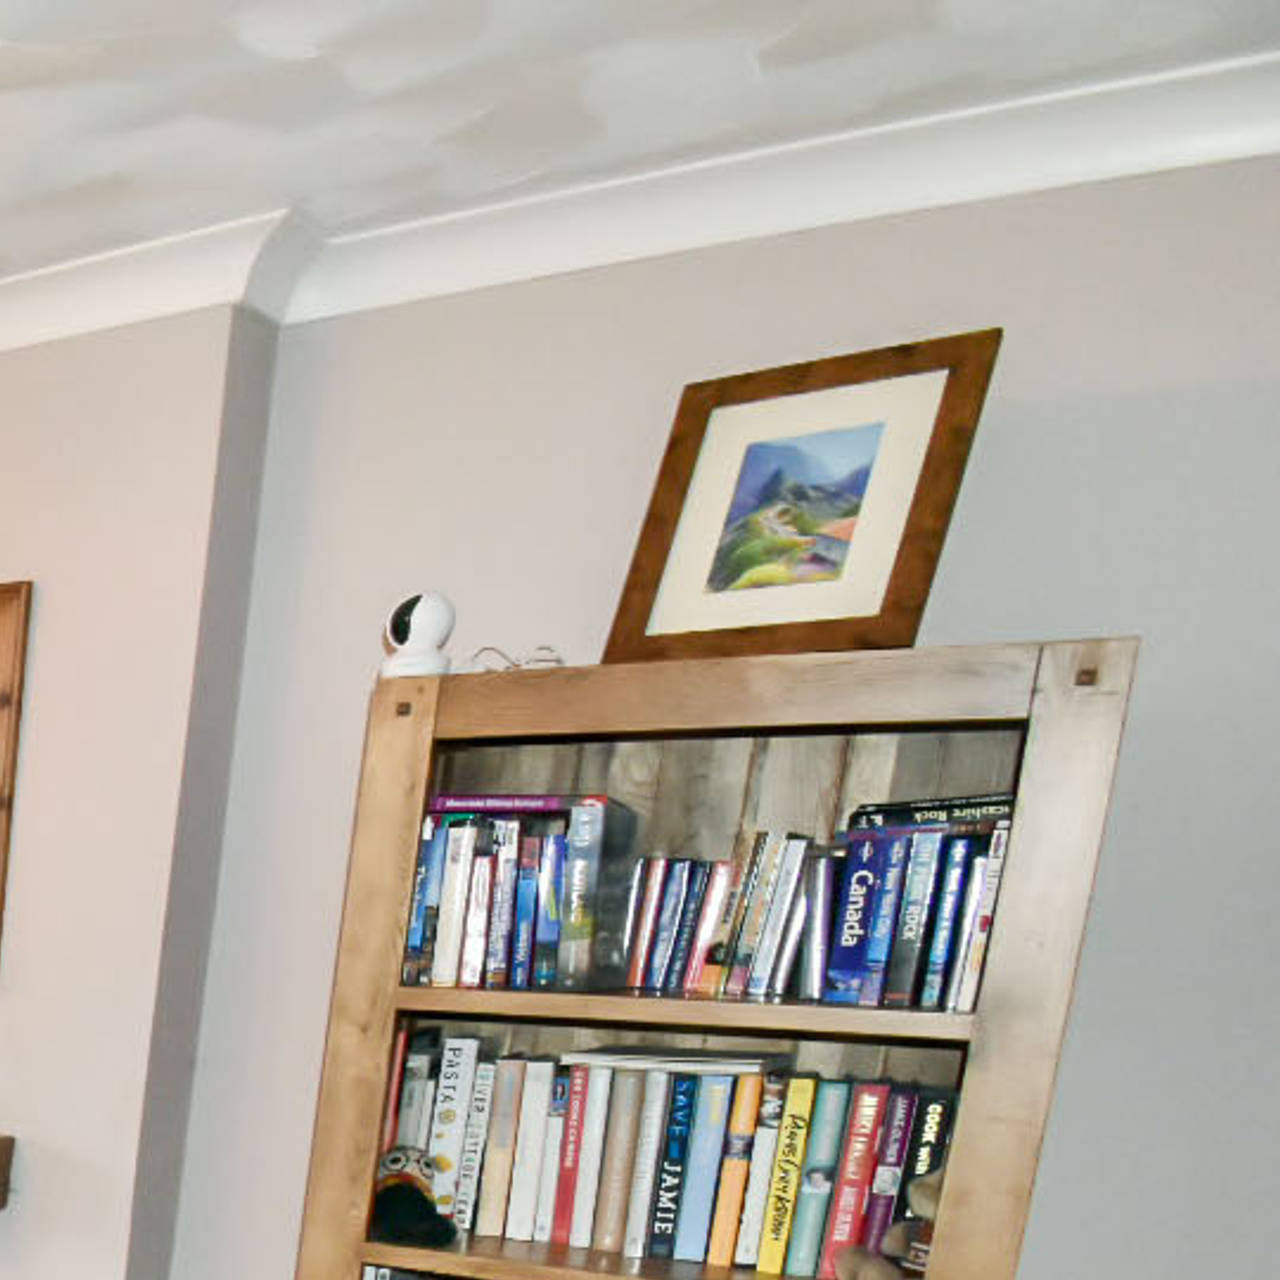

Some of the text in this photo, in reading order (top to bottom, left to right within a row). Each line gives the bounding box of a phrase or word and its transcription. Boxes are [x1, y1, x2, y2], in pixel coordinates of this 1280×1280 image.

[913, 810, 947, 827] Rock
[840, 869, 874, 948] Canada
[901, 904, 923, 941] ROCK
[439, 1046, 464, 1105] PASTA
[920, 1102, 944, 1144] COOK
[653, 1079, 694, 1236] SAVE JAMIE
